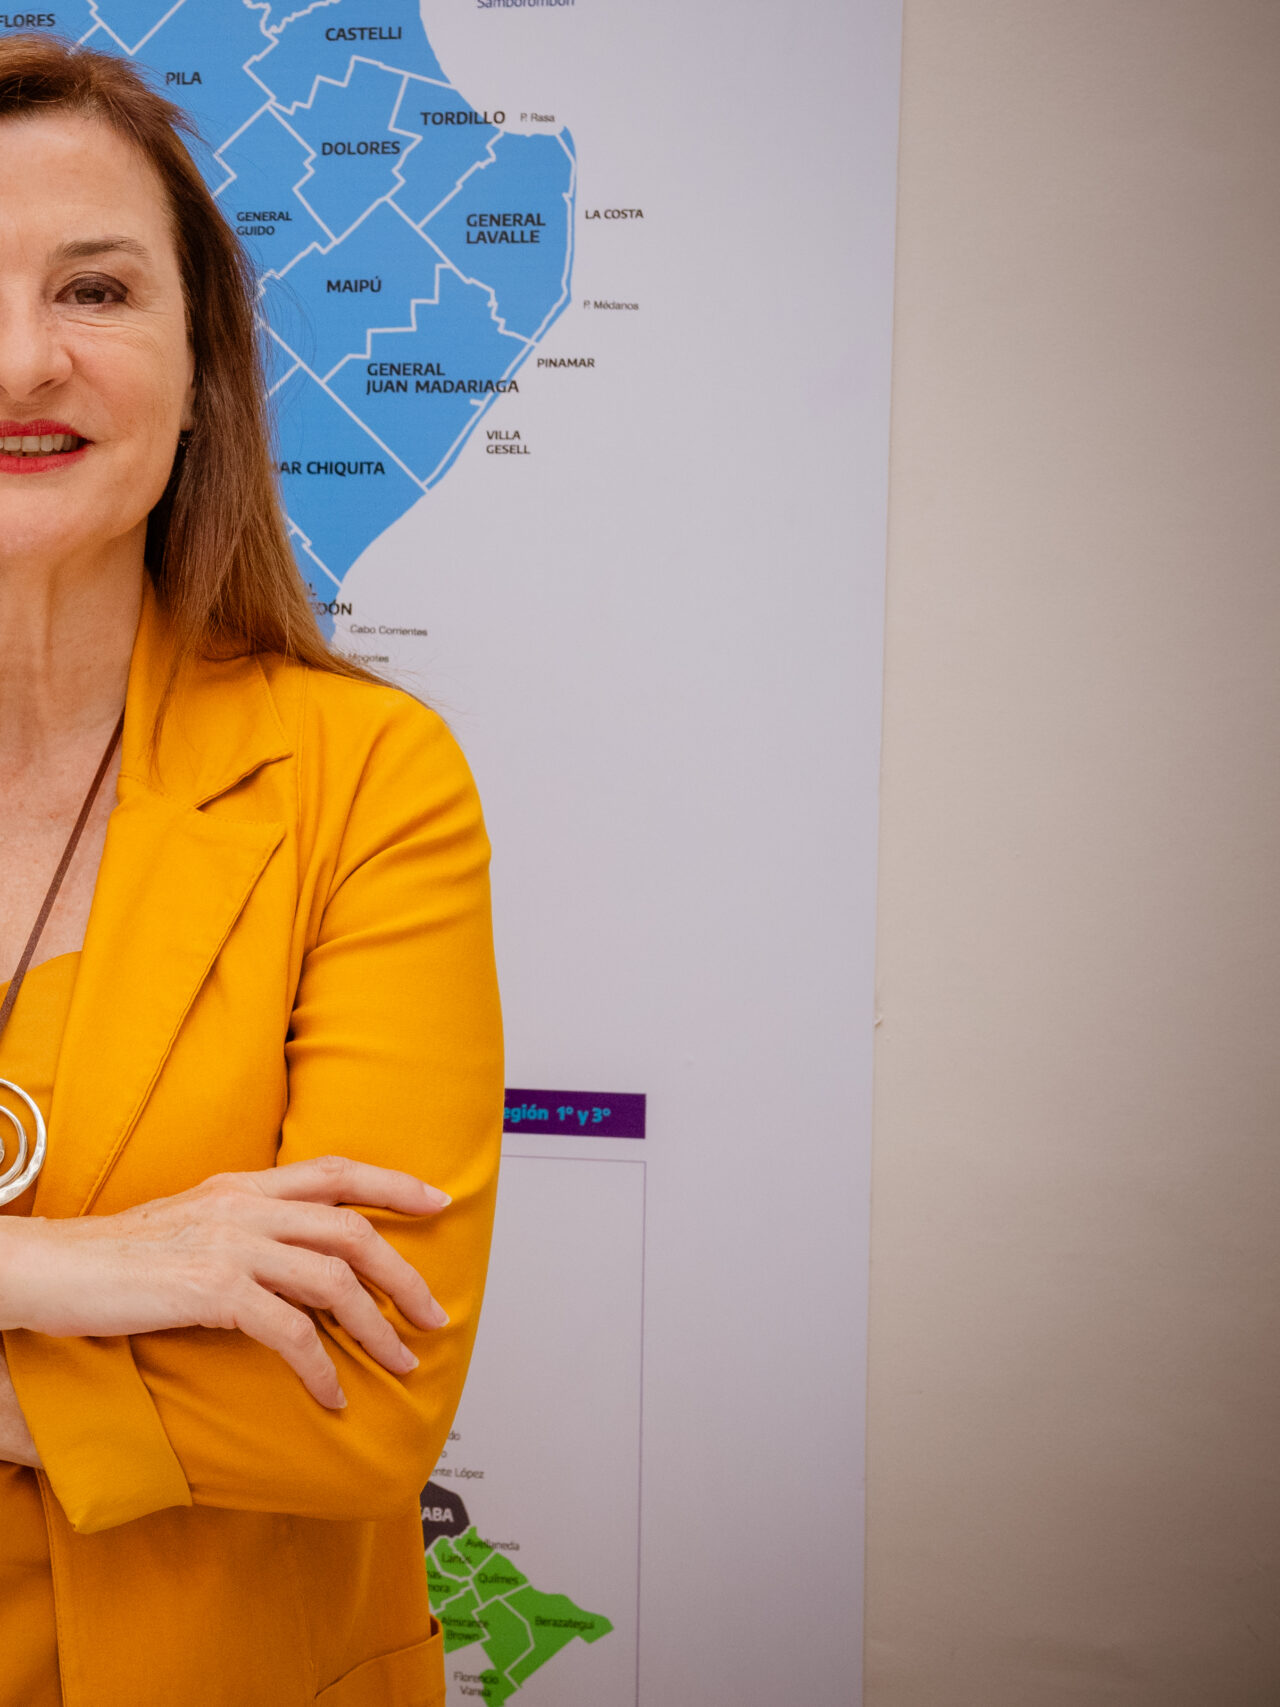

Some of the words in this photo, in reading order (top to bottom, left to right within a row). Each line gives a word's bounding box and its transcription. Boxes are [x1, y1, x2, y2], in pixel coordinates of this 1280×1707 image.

[325, 26, 402, 41] CASTELLI
[165, 71, 202, 86] PILA
[420, 110, 506, 126] TORDILLO
[520, 112, 528, 122] P.
[530, 112, 556, 123] Rasa
[321, 141, 401, 156] DOLORES
[236, 211, 293, 222] GENERAL
[466, 213, 546, 227] GENERAL
[585, 210, 601, 220] LA
[604, 209, 644, 220] COSTA
[236, 225, 276, 236] GUIDO
[466, 230, 541, 244] LAVALLE
[326, 275, 382, 293] MAIPÚ
[593, 301, 639, 311] Médanos
[367, 363, 446, 377] GENERAL
[537, 358, 596, 369] PINAMAR
[366, 380, 408, 395] JUAN
[415, 380, 520, 394] MADARIAGA
[486, 430, 521, 441] VILLA
[486, 444, 531, 455] GESELL
[280, 461, 302, 475] AR
[306, 461, 386, 477] CHIQUITA
[350, 624, 376, 635] Cabo
[504, 1103, 549, 1124] egión
[577, 1109, 589, 1127] y
[454, 1467, 484, 1480] López
[421, 1506, 454, 1523] ABA
[477, 1573, 519, 1587] Quilmes
[534, 1615, 595, 1631] Berazategui
